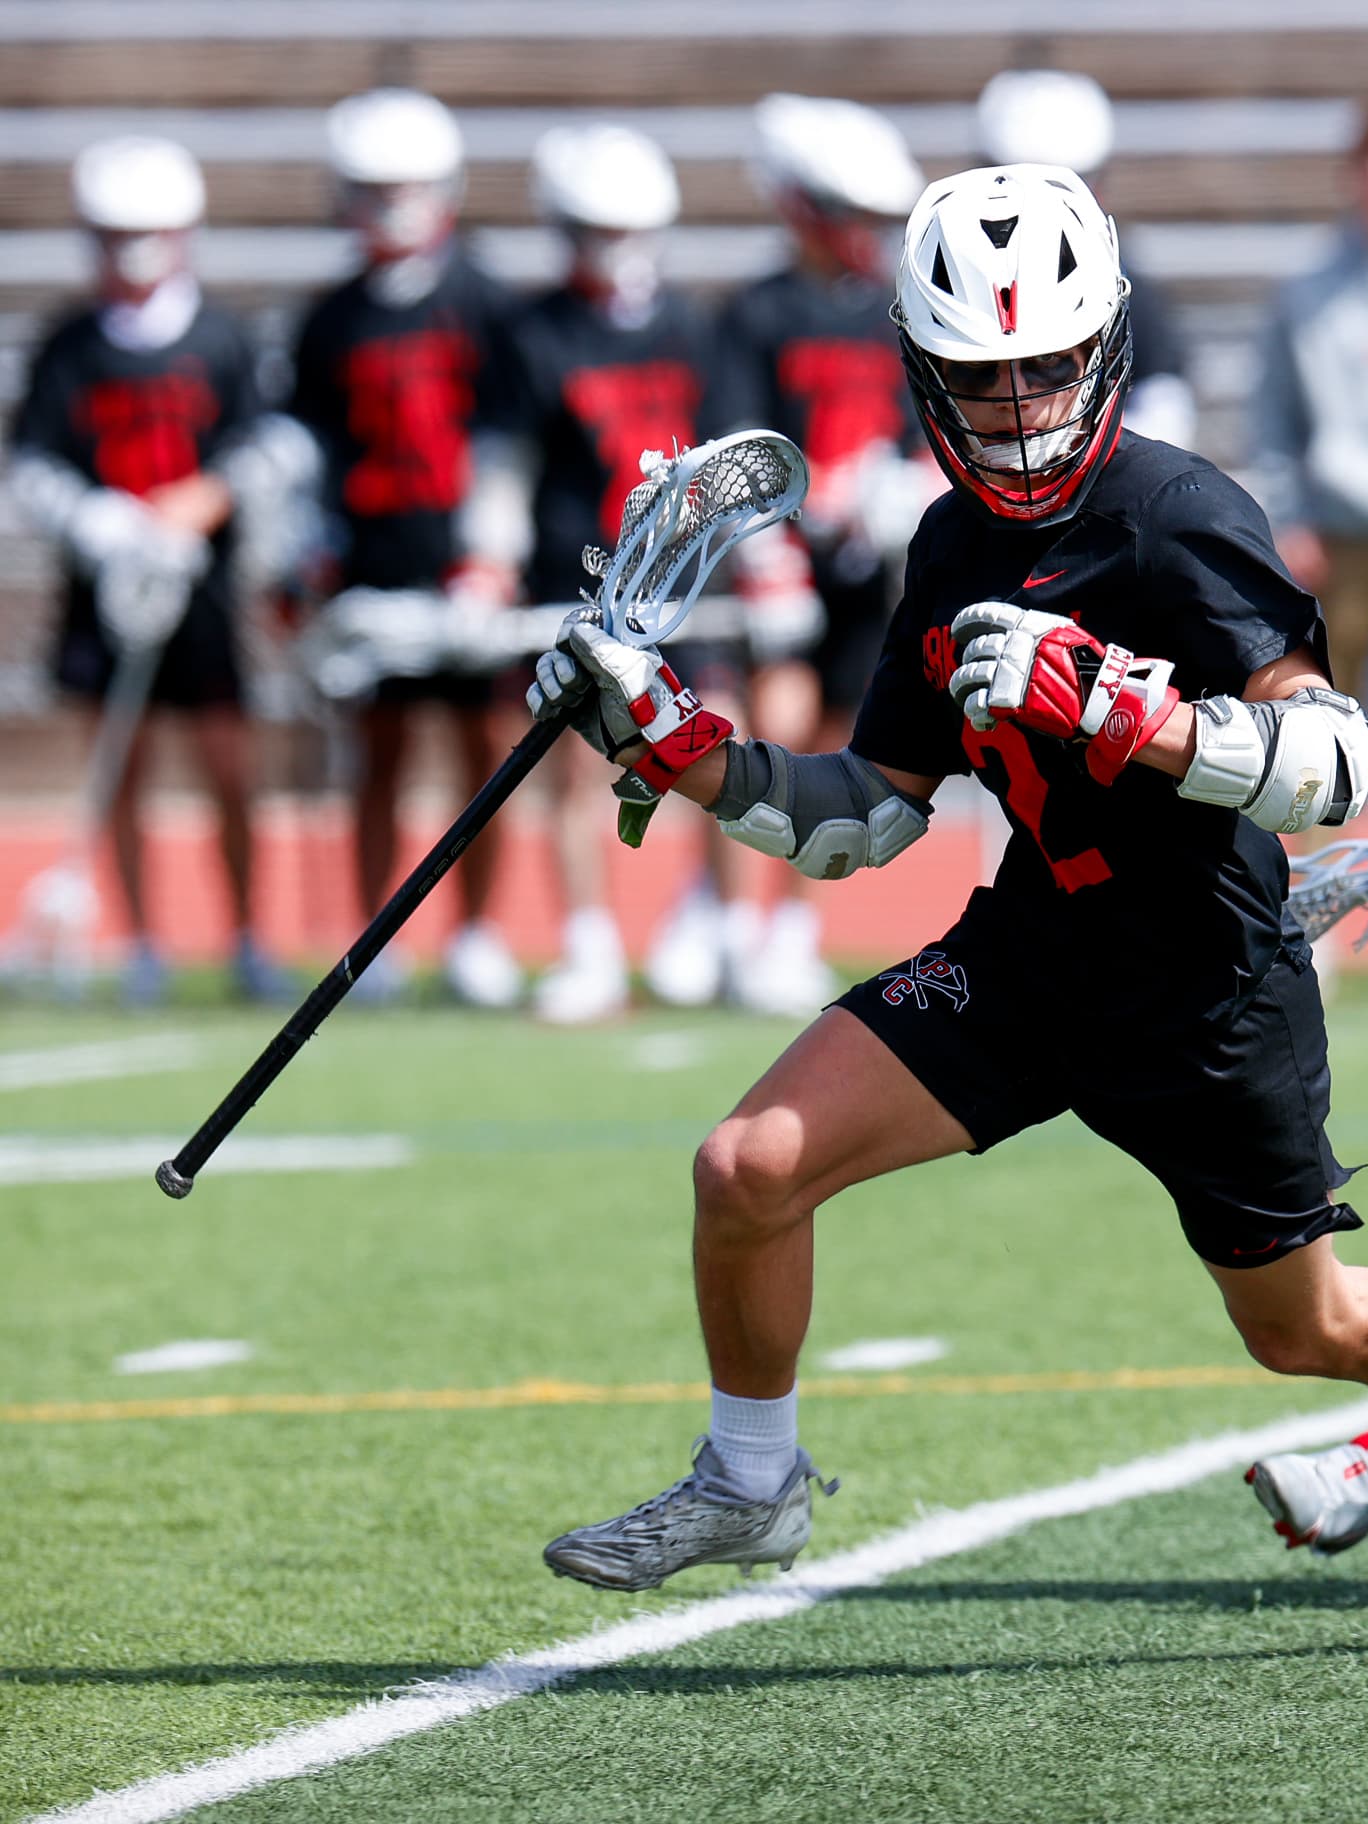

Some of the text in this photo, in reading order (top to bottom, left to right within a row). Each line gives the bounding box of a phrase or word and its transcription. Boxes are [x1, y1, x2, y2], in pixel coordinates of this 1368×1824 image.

[961, 714, 1113, 894] 2
[917, 959, 952, 978] P
[882, 974, 915, 1006] C
